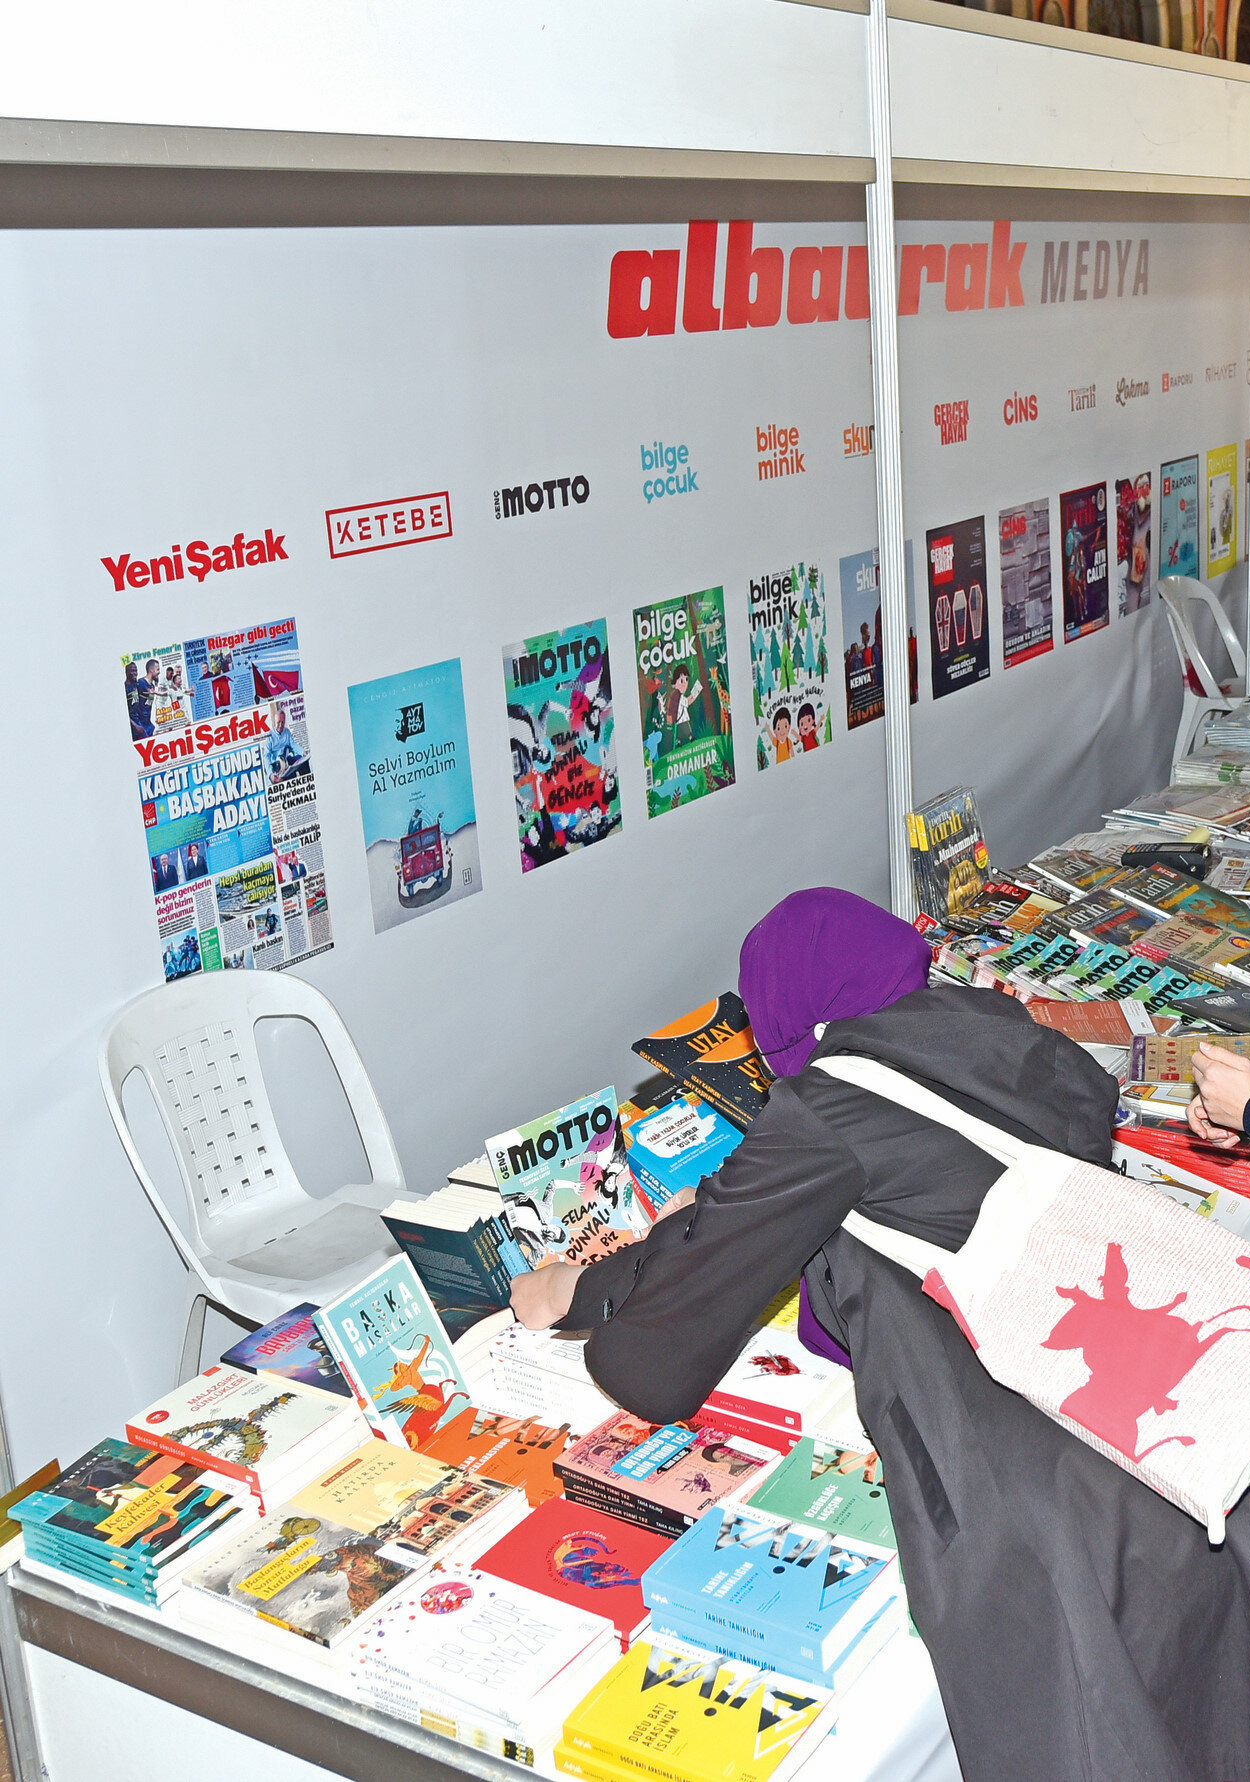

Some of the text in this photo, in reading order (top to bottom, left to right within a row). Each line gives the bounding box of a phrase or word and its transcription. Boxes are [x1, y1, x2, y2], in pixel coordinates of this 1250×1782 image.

[1040, 238, 1149, 305] MEDYA
[1116, 377, 1149, 407] Lokma
[1170, 374, 1193, 388] RAPORU
[934, 400, 969, 428] GERÇEK
[1003, 392, 1038, 426] CİNS
[756, 424, 799, 457] bilge
[941, 420, 968, 446] HAYAT
[640, 442, 689, 476] bilge
[757, 449, 805, 481] minik
[502, 474, 590, 518] MOTTO
[642, 467, 699, 504] çocuk
[1172, 474, 1196, 491] RAPORU
[337, 504, 444, 546] KETEBE
[1001, 516, 1026, 539] CİNS
[99, 528, 290, 592] Yeni Şafak
[930, 544, 954, 561] GERÇEK
[934, 560, 953, 574] HAYAT
[750, 575, 792, 605] bilge
[637, 608, 687, 642] bilge
[752, 597, 800, 632] minik
[207, 620, 295, 651] Rüzgar gibi geçti
[132, 643, 182, 661] Zirve Fener'in
[519, 636, 602, 686] MOTTO
[639, 634, 697, 675] çocuk
[850, 675, 872, 690] KENYA
[406, 705, 422, 718] AYT
[407, 722, 424, 733] TOV
[408, 715, 421, 725] MA
[134, 710, 271, 768] Yeni Şafak
[140, 745, 262, 801] KAĞIT ÜSTÜNDE
[368, 740, 456, 778] Selvi Boylum
[667, 749, 718, 781] ORMANLAR
[268, 774, 315, 795] ABD ASKERİ
[372, 757, 456, 796] Al Yazmalım
[168, 769, 265, 821] BAŞBAKAN
[268, 783, 315, 804] Suriye'den de
[282, 793, 317, 811] ÇIKMALI
[212, 795, 268, 834] ADAYI
[300, 832, 321, 847] TALİP
[939, 828, 979, 862] Muhammed
[219, 861, 273, 887] Hepsi buradan
[243, 874, 274, 892] kaçmaya
[1127, 875, 1175, 900] Tarih
[154, 878, 212, 905] K-pop gençlerin
[157, 896, 194, 917] değil bizim
[158, 906, 195, 925] sorunumuz
[996, 941, 1047, 970] MOTTO
[1031, 944, 1077, 976] MOTTO
[1105, 965, 1153, 1001] MOTTO
[1143, 977, 1189, 1016] MOTTO
[686, 1020, 737, 1055] UZAY
[639, 1050, 651, 1061] UZAY
[683, 1079, 696, 1090] UZAY
[690, 1074, 703, 1084] UZAY
[496, 1151, 510, 1180] GENÇ
[507, 1104, 612, 1176] MOTTO
[561, 1201, 598, 1227] SELAM
[566, 1208, 611, 1261] DÜNYALI
[341, 1281, 414, 1344] BAŞKA
[353, 1301, 421, 1358] MASALLAR
[187, 1373, 239, 1405] MALAZGİRT
[190, 1376, 248, 1412] GÜNLÜKLERİ
[620, 1429, 676, 1470] ORTADOĞU'YA
[630, 1432, 694, 1478] DAİR YİRMİ TEZ
[331, 1460, 384, 1497] HATIRDA
[336, 1461, 396, 1504] KALANLAR
[104, 1481, 166, 1530] Keyfekader
[620, 1490, 630, 1500] TEZ
[637, 1499, 648, 1508] TAHA
[803, 1483, 840, 1518] ÖZGÜRLÜĞE
[816, 1496, 845, 1522] KAÇIŞIM
[117, 1499, 161, 1534] Kahvesi
[638, 1515, 648, 1523] TEZ
[244, 1540, 309, 1589] Başlangıçların
[252, 1568, 286, 1592] Sonsuz
[263, 1560, 310, 1595] Mutluluğu
[713, 1561, 754, 1599] TANIKLIĞIM
[701, 1569, 729, 1594] TARİHE
[705, 1612, 765, 1642] TARİHE TANIKLIĞIM
[715, 1645, 776, 1672] TARİHE TANIKLIĞIM
[628, 1702, 669, 1743] DOĞU BATI
[642, 1709, 679, 1748] ARASINDA
[654, 1727, 681, 1753] İSLAM
